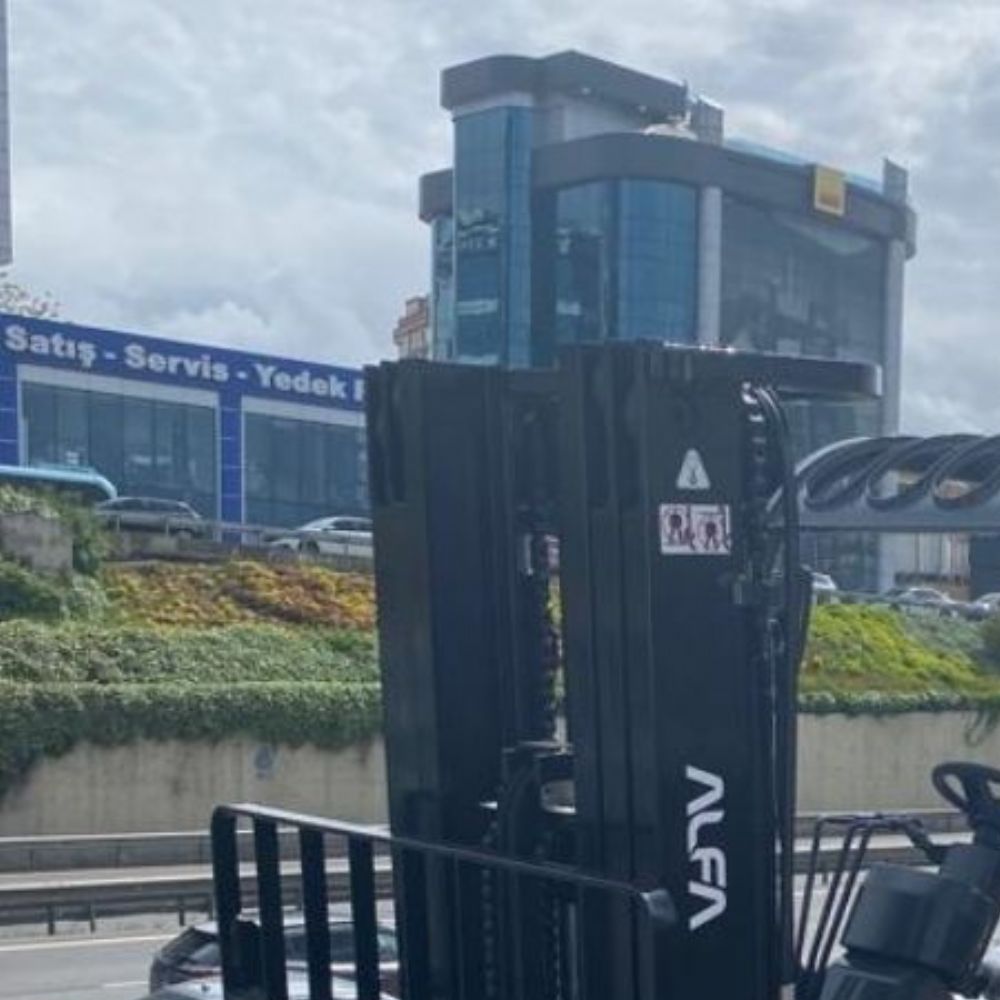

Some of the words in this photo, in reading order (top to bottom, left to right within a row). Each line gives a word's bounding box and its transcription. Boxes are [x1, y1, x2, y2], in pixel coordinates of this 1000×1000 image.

[5, 325, 97, 369] Satış
[124, 344, 230, 382] Servis
[252, 362, 348, 399] Yedek
[686, 764, 728, 931] ALFA
